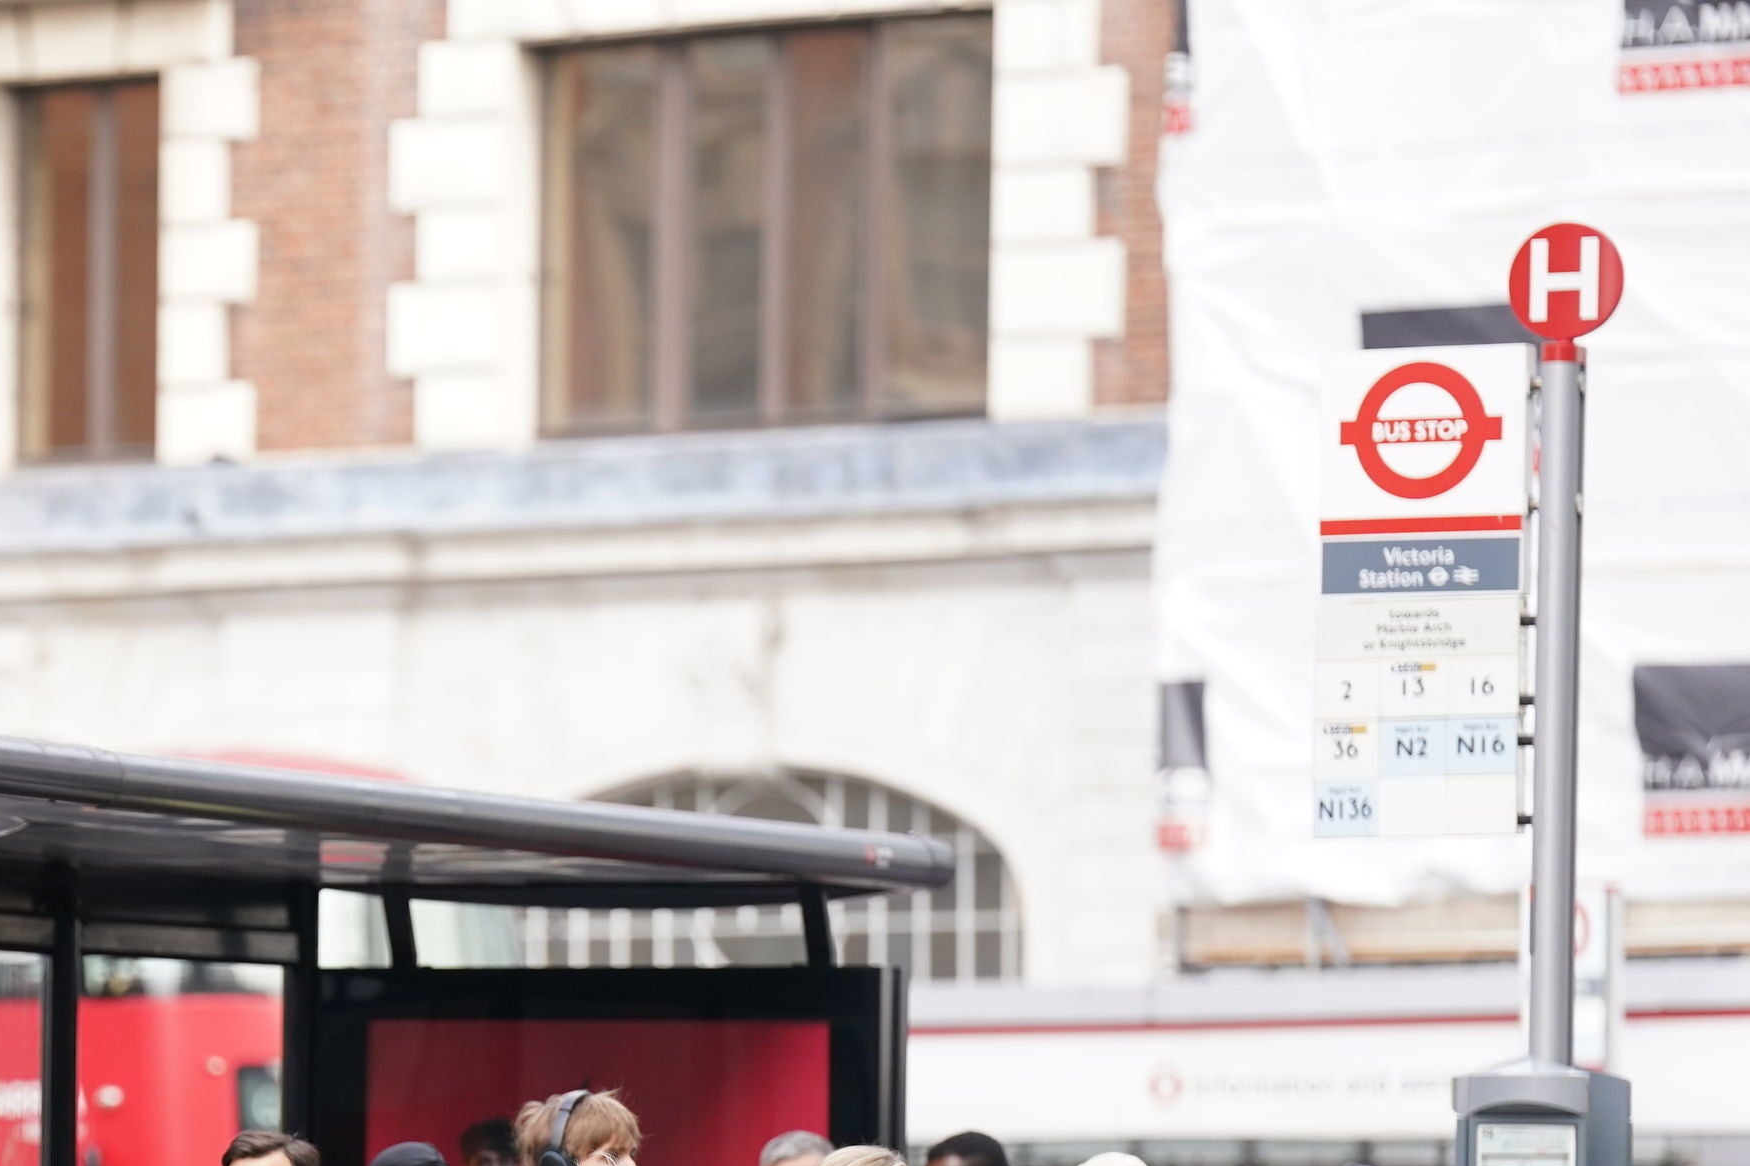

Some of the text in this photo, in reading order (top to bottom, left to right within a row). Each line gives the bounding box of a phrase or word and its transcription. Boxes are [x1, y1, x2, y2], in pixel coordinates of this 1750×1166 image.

[1530, 235, 1599, 322] H
[1372, 419, 1468, 442] BUS STOP
[1383, 546, 1455, 567] Victoria
[1358, 568, 1424, 589] Station
[1341, 680, 1352, 700] 2
[1401, 677, 1425, 697] 13
[1470, 676, 1495, 696] 16
[1332, 737, 1359, 759] 36
[1395, 737, 1428, 759] N2
[1457, 734, 1505, 756] N16
[1319, 798, 1372, 821] N136
